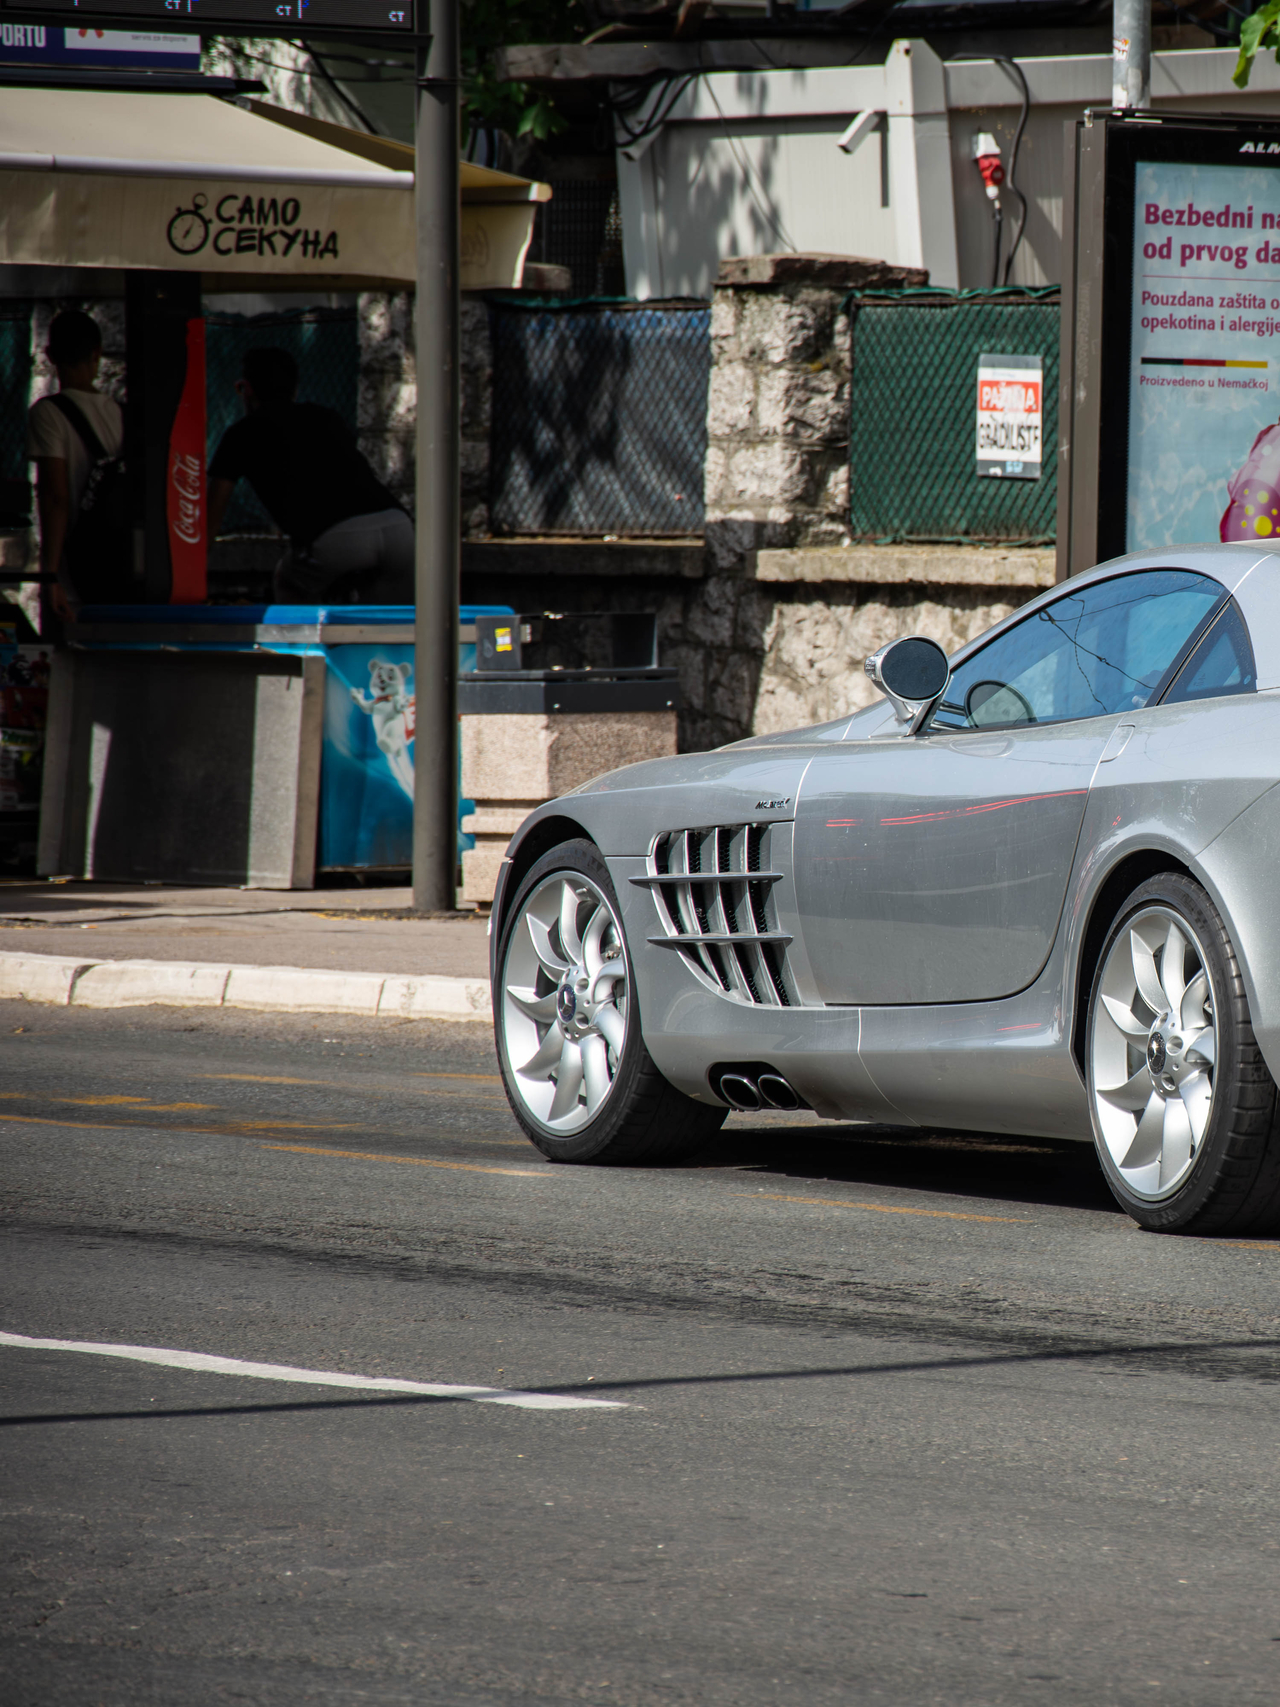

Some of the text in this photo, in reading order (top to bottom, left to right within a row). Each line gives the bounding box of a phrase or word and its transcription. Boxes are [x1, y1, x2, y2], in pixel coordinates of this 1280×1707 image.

[216, 194, 301, 226] САМО
[1145, 203, 1253, 230] Bezbedni
[1143, 236, 1172, 261] od
[1180, 242, 1248, 270] prvog
[1141, 290, 1214, 311] Pouzdana
[1218, 292, 1266, 311] zaštita
[1141, 314, 1215, 333] opekotina
[1220, 317, 1224, 331] i
[1140, 374, 1269, 392] Proizvedeno u Nemačkoj
